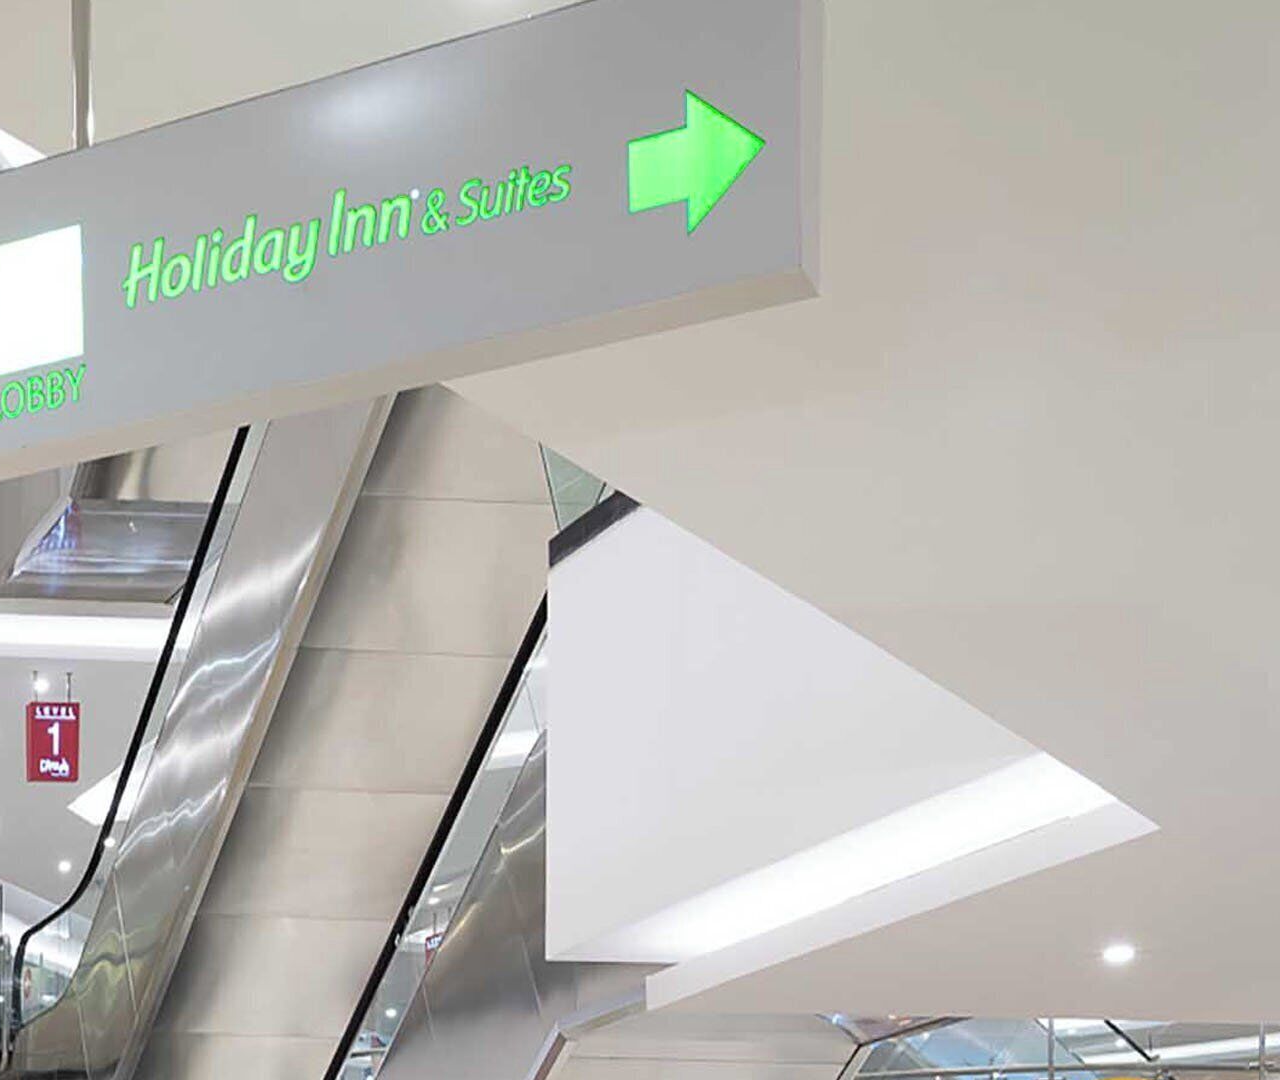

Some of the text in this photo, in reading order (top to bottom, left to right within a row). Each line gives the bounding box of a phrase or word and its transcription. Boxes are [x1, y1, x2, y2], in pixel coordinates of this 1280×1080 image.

[124, 164, 572, 308] Holiday Inn & Suites
[47, 721, 60, 756] 1
